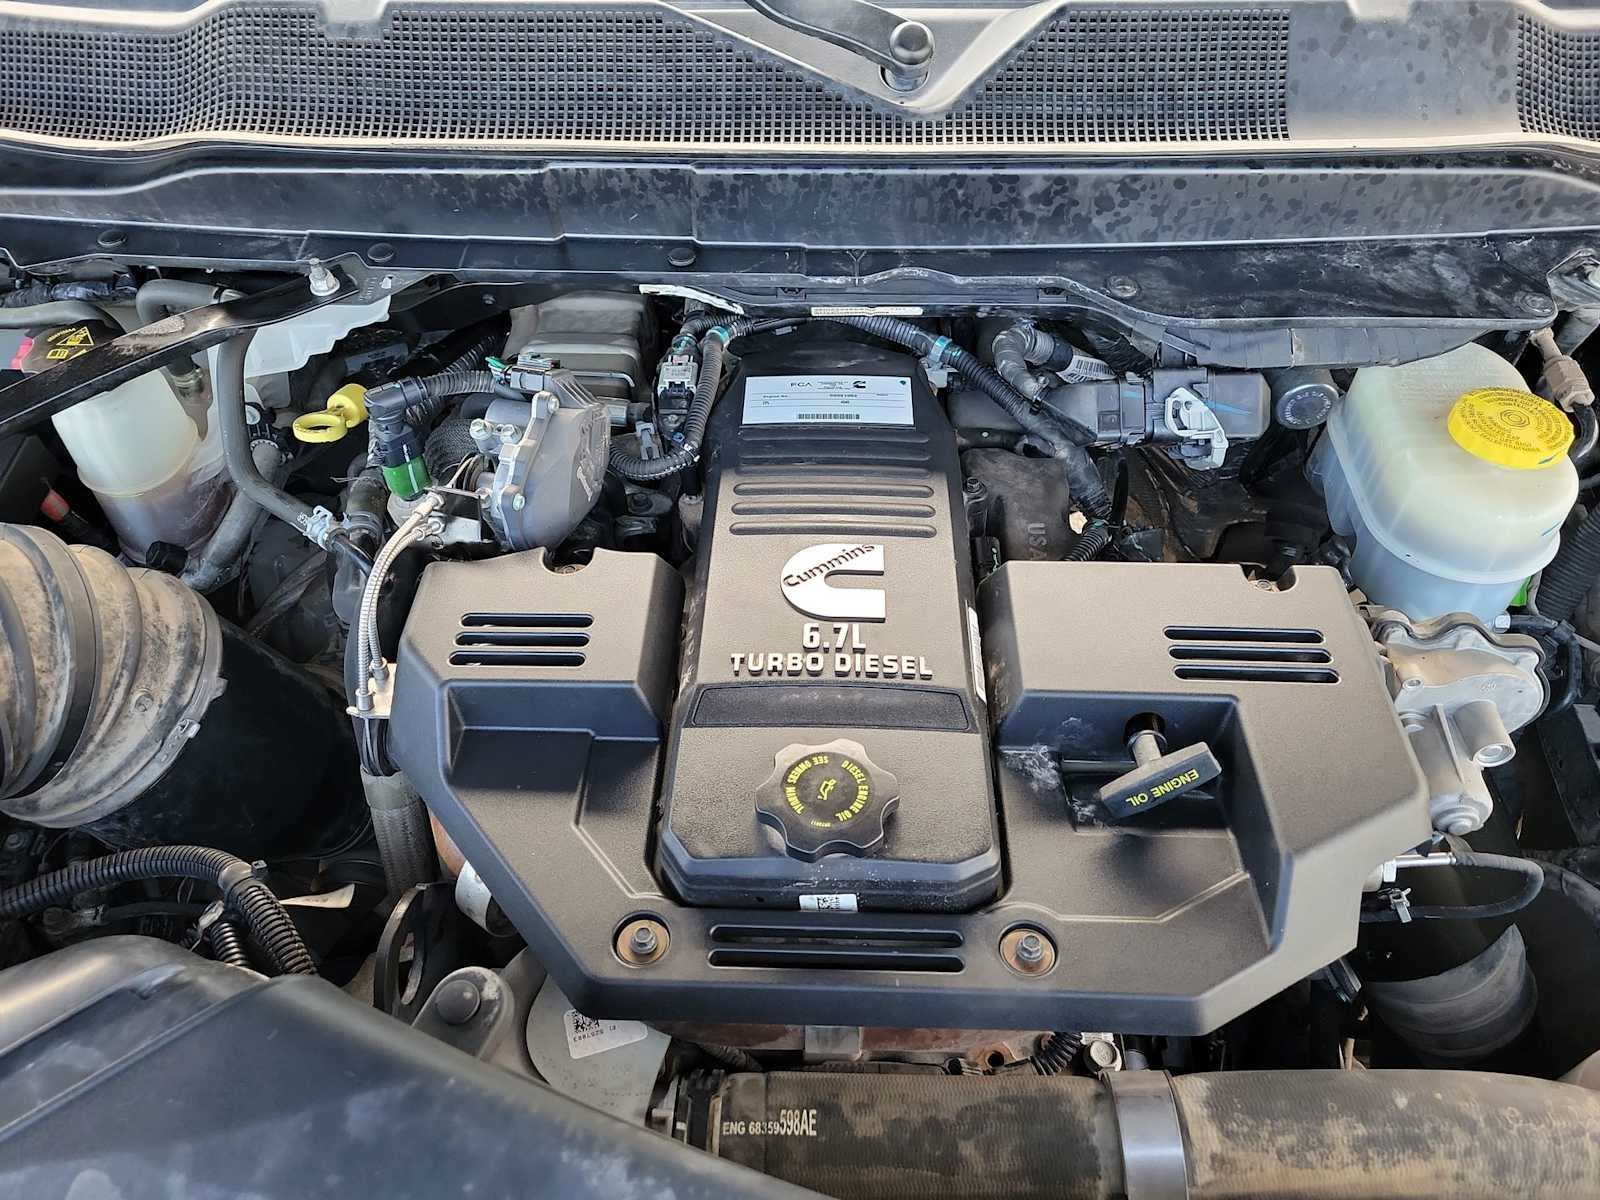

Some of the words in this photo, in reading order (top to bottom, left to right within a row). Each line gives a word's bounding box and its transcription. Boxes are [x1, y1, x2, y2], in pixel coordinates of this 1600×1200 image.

[1028, 522, 1047, 559] USA
[783, 544, 875, 586] Cummins
[802, 623, 866, 652] 6.7L
[731, 653, 824, 676] TURBO
[834, 653, 933, 679] DIESEL
[811, 755, 829, 766] SEE
[841, 760, 866, 784] DIESEL
[1150, 769, 1199, 797] ENGINE
[785, 786, 805, 815] MANUAL
[849, 785, 869, 814] ENGINE
[1125, 792, 1149, 807] OIL
[835, 808, 853, 822] OIL
[722, 1121, 746, 1136] ENG
